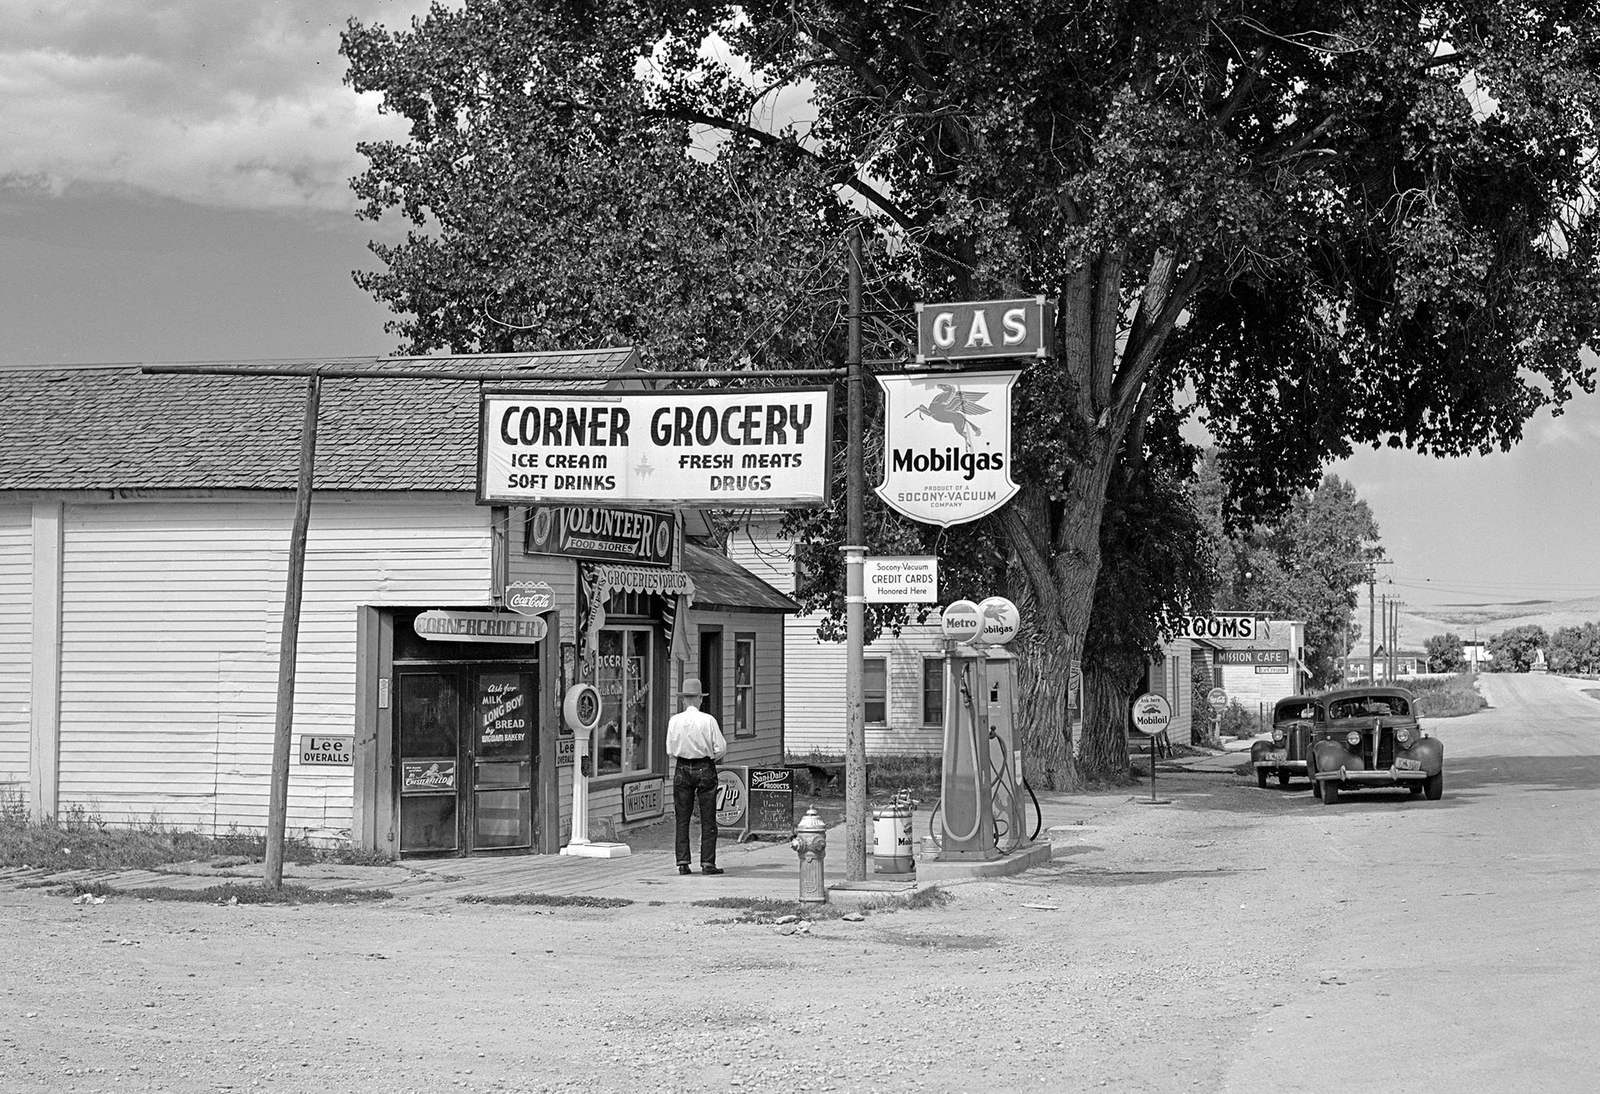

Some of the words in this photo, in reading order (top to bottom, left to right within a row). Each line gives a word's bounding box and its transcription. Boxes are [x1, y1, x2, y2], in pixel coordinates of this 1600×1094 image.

[933, 308, 1027, 350] GAS
[500, 406, 631, 446] CORNER
[650, 404, 813, 446] GROCERY
[511, 454, 539, 468] ICE
[545, 455, 608, 469] CREAM
[678, 454, 734, 469] FRESH
[742, 453, 802, 468] MEATS
[893, 447, 1004, 481] Mobilgas
[508, 475, 548, 490] SOFT
[554, 475, 616, 491] DRINKS
[710, 475, 772, 490] DRUGS
[898, 492, 997, 501] SOCONY-VACUUM
[560, 507, 653, 557] VOLUNTEER
[570, 539, 595, 550] FOOD
[597, 542, 635, 553] STORES
[607, 571, 660, 589] GROCERIES
[663, 574, 687, 589] DRUGS
[872, 575, 902, 583] CREDIT
[906, 574, 934, 583] CARDS
[877, 587, 908, 595] Honored
[910, 587, 928, 595] Here
[511, 594, 551, 608] Coca-Cola
[947, 618, 977, 629] Metro
[983, 625, 1014, 635] obilgas
[1178, 617, 1252, 638] ROOMS
[1218, 653, 1252, 662] MISSION
[1257, 653, 1282, 662] CAFE
[487, 684, 503, 693] Ask
[503, 683, 517, 696] for
[482, 695, 503, 705] MILK
[483, 705, 505, 726] LONG
[1137, 715, 1168, 725] Mobiloil
[495, 719, 525, 729] BREAD
[484, 727, 495, 736] by
[311, 738, 343, 752] Lee
[560, 741, 575, 754] Lee
[304, 753, 350, 763] OVERALLS
[628, 793, 657, 811] WHISTLE
